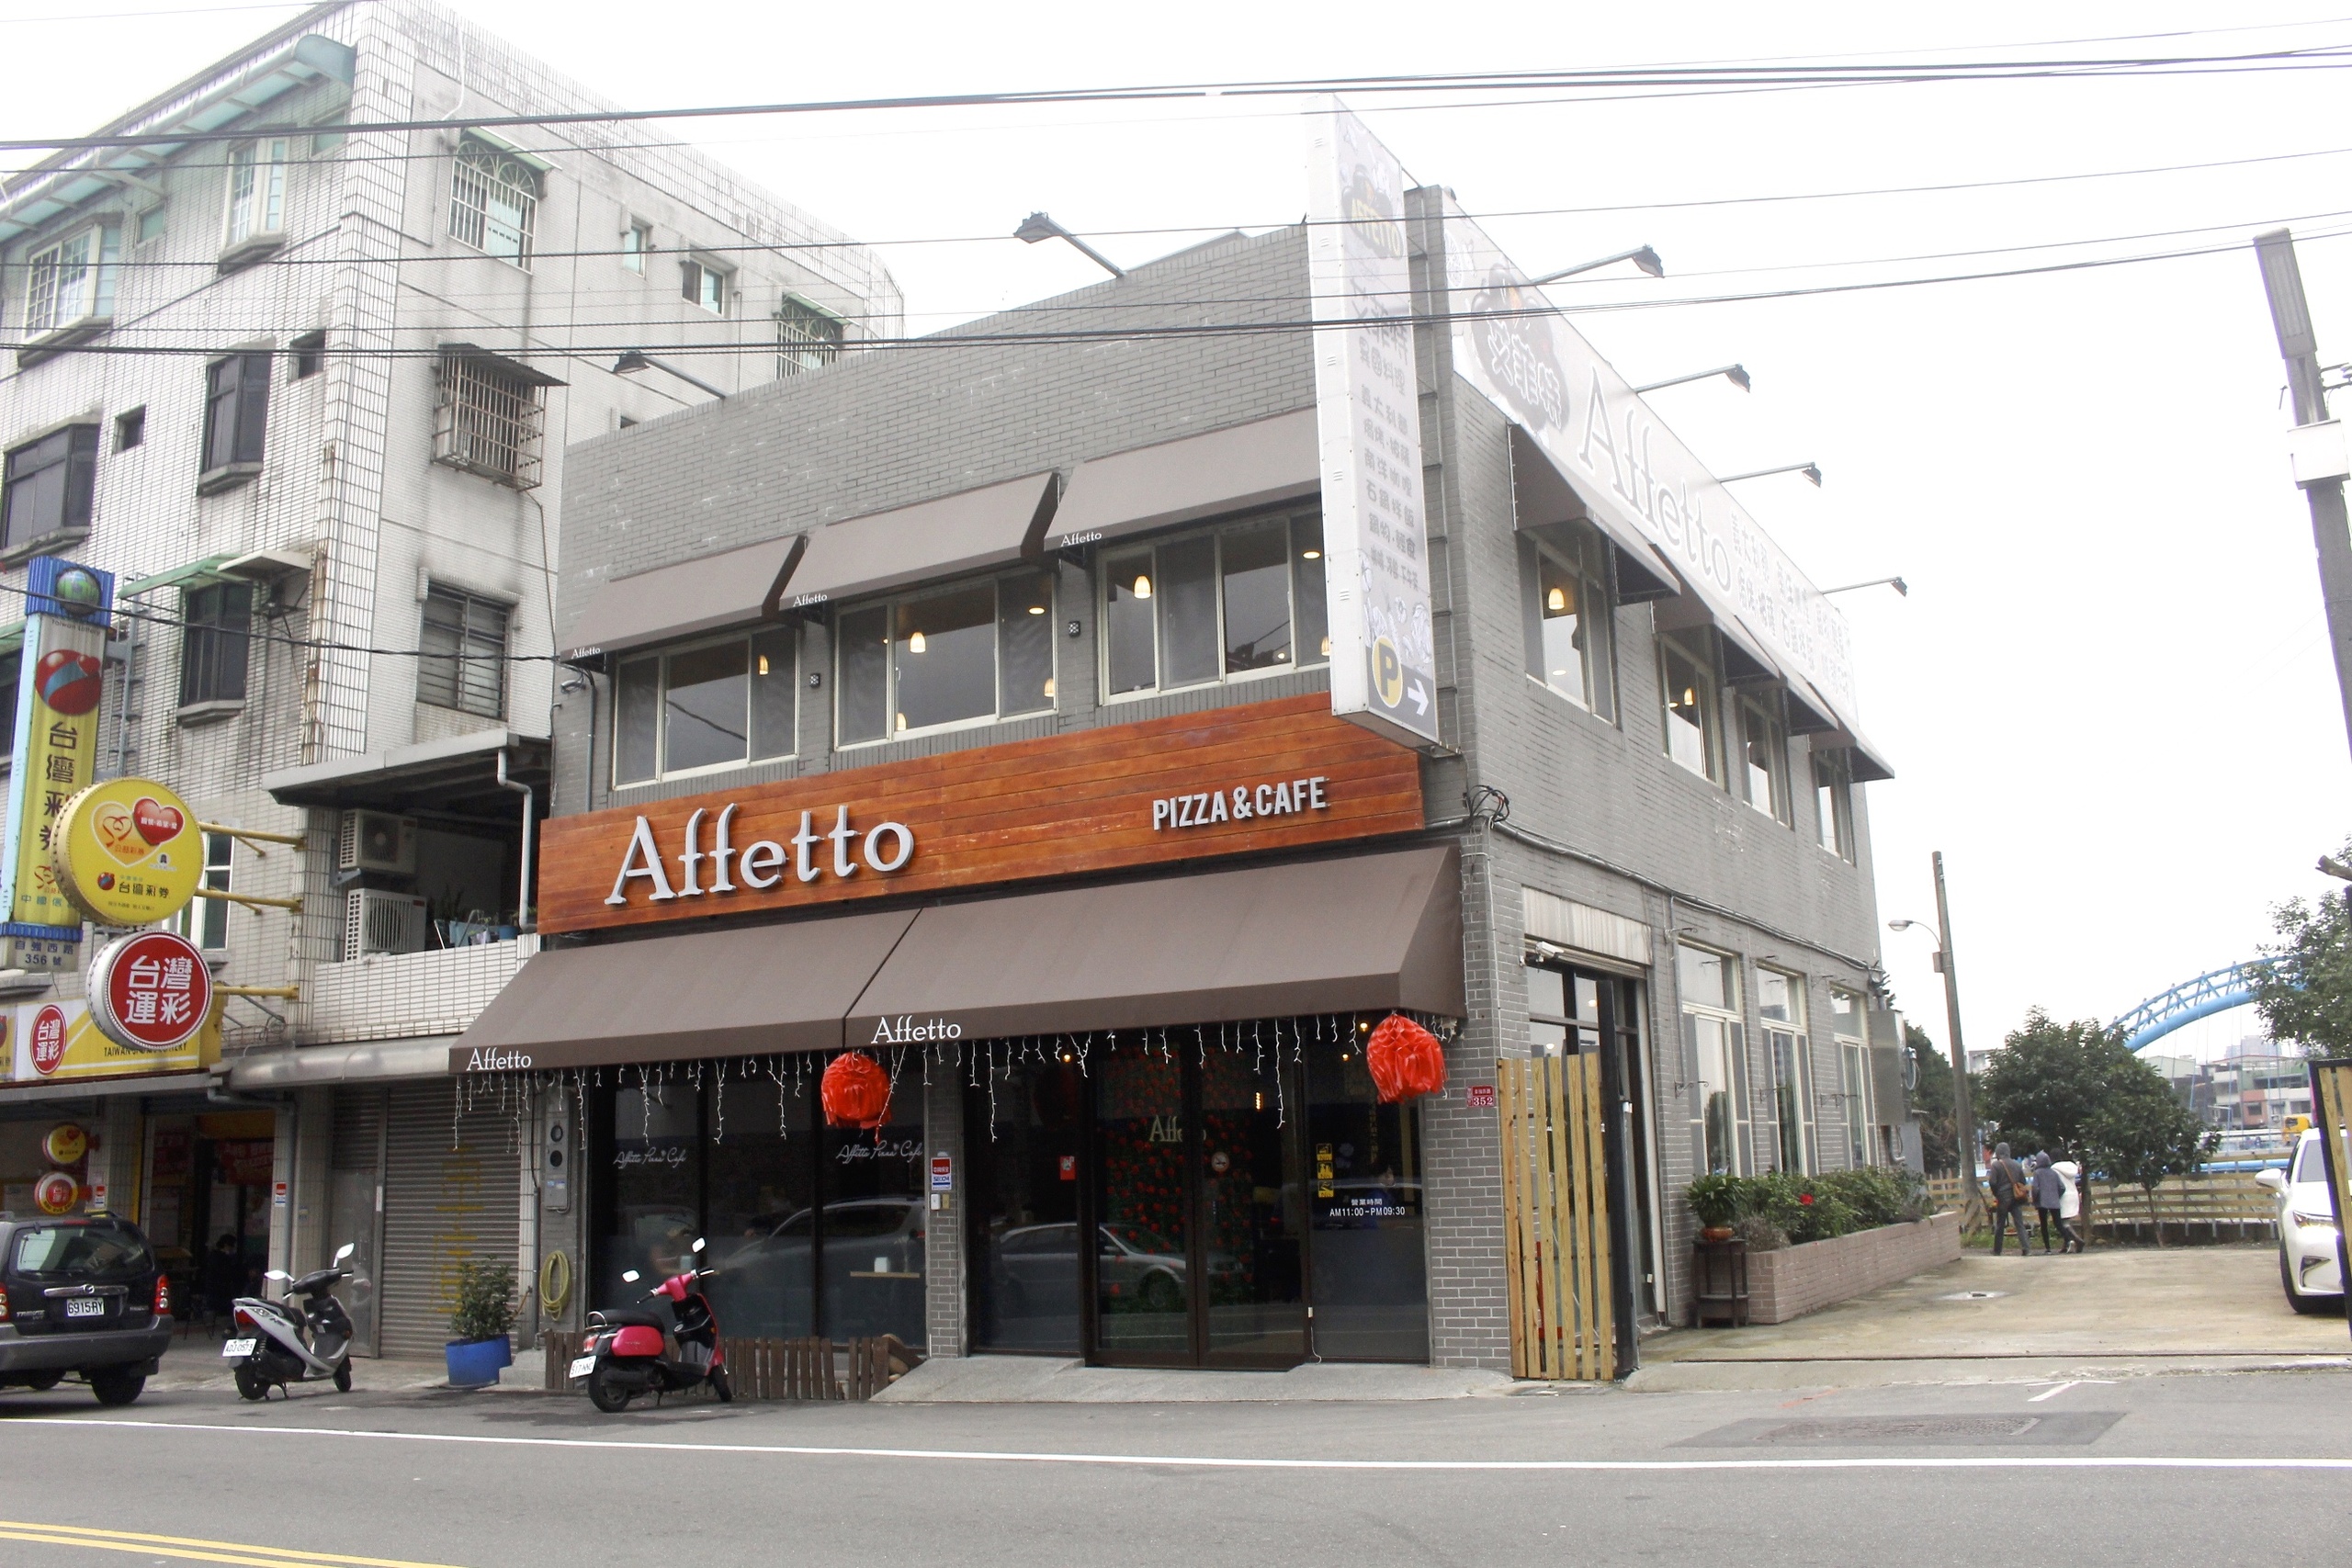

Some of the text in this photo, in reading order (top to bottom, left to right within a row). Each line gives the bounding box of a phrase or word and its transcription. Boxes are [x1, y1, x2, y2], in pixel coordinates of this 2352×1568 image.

[1577, 363, 1733, 597] Affetto
[1060, 530, 1102, 547] Affetto
[793, 592, 828, 607] Affetto
[571, 647, 601, 660] Affetto
[1379, 644, 1400, 700] P
[604, 803, 915, 906] Affetto
[119, 882, 169, 898] 台灣彩券
[15, 940, 74, 954] 自強西路
[25, 954, 48, 965] 356
[128, 954, 194, 990] 台灣
[124, 990, 192, 1025] 運彩
[38, 1019, 61, 1041] 台灣
[871, 1016, 962, 1044] Affetto
[36, 1041, 60, 1062] 運彩
[466, 1048, 532, 1071] Affetto
[1474, 1096, 1493, 1106] 352
